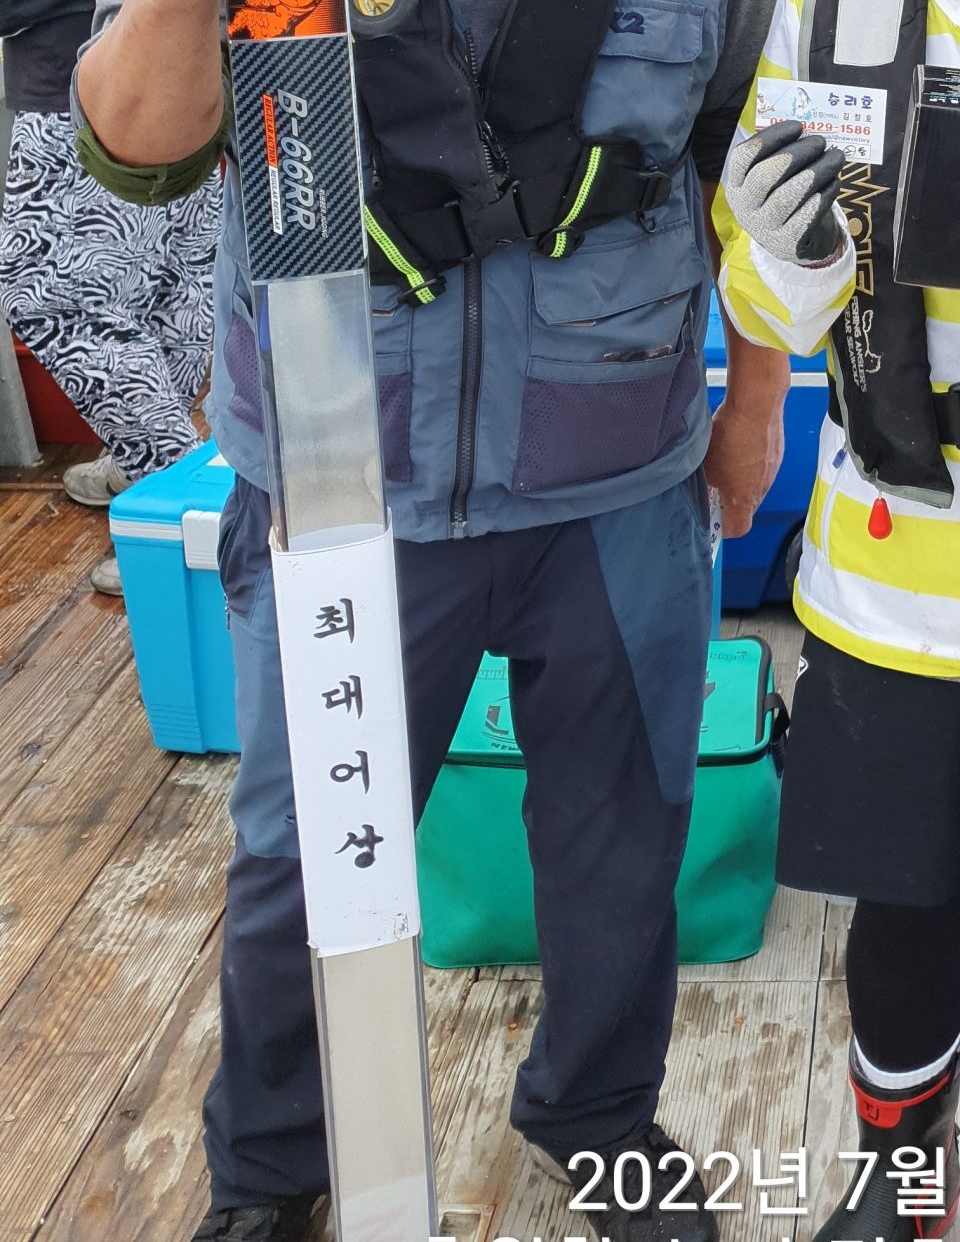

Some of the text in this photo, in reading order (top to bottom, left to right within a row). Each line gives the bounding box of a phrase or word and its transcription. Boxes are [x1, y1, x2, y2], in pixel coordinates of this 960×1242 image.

[828, 92, 873, 109] 승리호
[277, 89, 316, 231] B-66RR
[851, 296, 862, 338] FISHING
[846, 335, 859, 387] SEAWOLF
